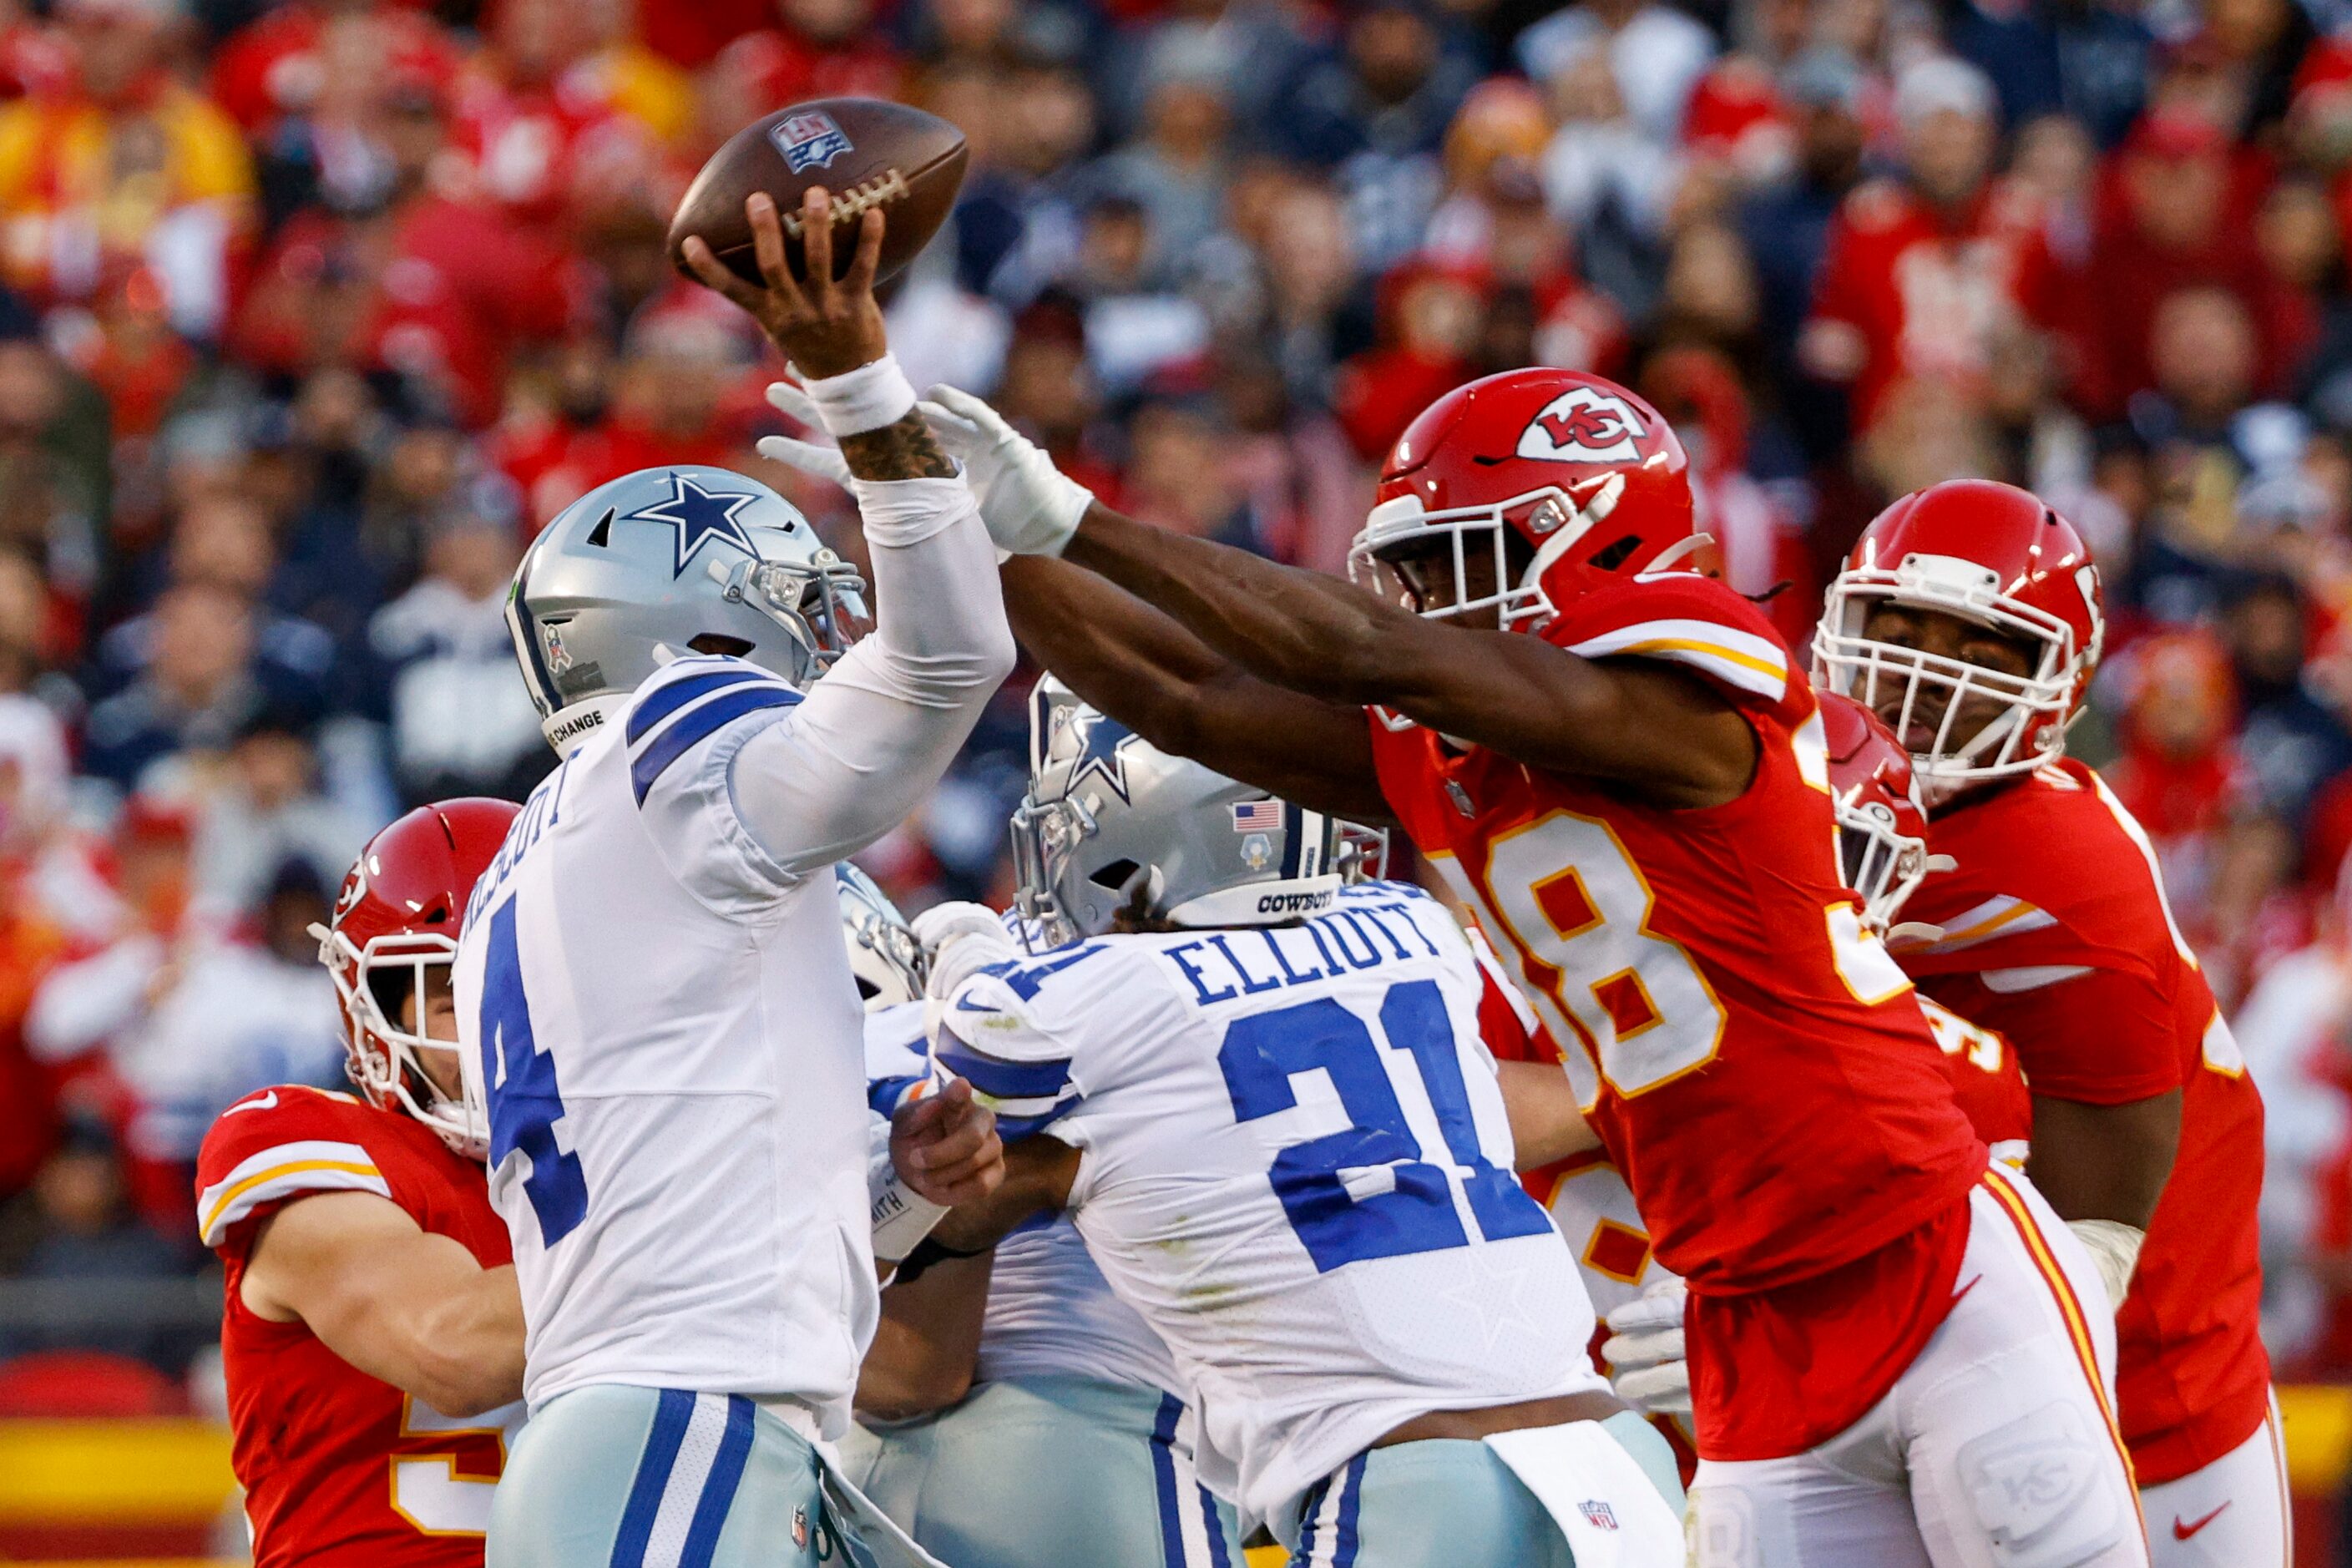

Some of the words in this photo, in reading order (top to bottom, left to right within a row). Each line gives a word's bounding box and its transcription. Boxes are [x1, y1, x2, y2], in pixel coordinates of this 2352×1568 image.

[1536, 402, 1631, 450] KC
[554, 711, 604, 742] CHANGE
[1161, 902, 1440, 1007] ELLIOTT
[479, 888, 589, 1251] 4
[1216, 978, 1555, 1275] 21
